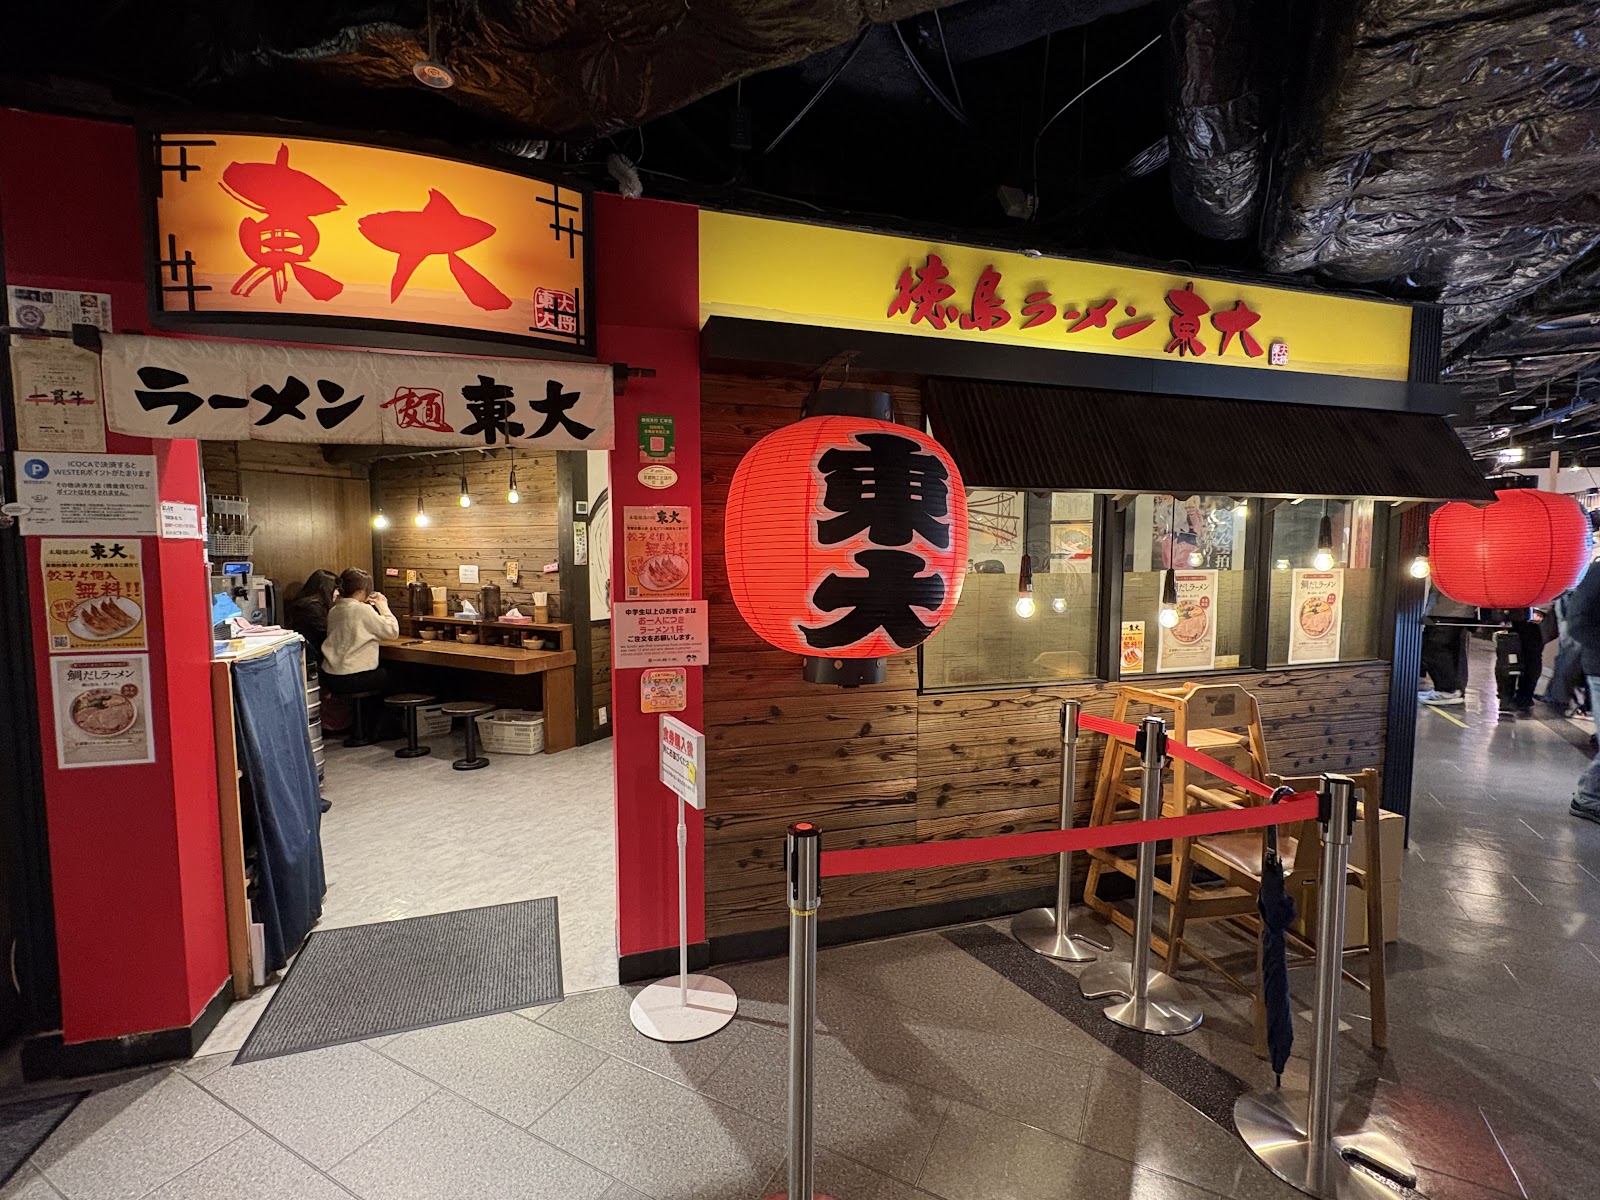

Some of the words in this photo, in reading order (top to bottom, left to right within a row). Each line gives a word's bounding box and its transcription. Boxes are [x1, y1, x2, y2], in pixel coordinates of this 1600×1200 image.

[217, 142, 513, 312] 東大
[887, 253, 1264, 358] 徳島ラーメン東大
[134, 366, 365, 430] ラーメン
[459, 375, 597, 445] 東大
[656, 510, 682, 524] 東大
[797, 432, 950, 649] 東大
[90, 543, 128, 560] 東大
[625, 607, 697, 616] 中学生以上のお客さまは
[638, 616, 685, 625] お一人につき
[627, 634, 694, 643] ご注文をお願いします。
[67, 669, 135, 681] 鯛だしラーメン
